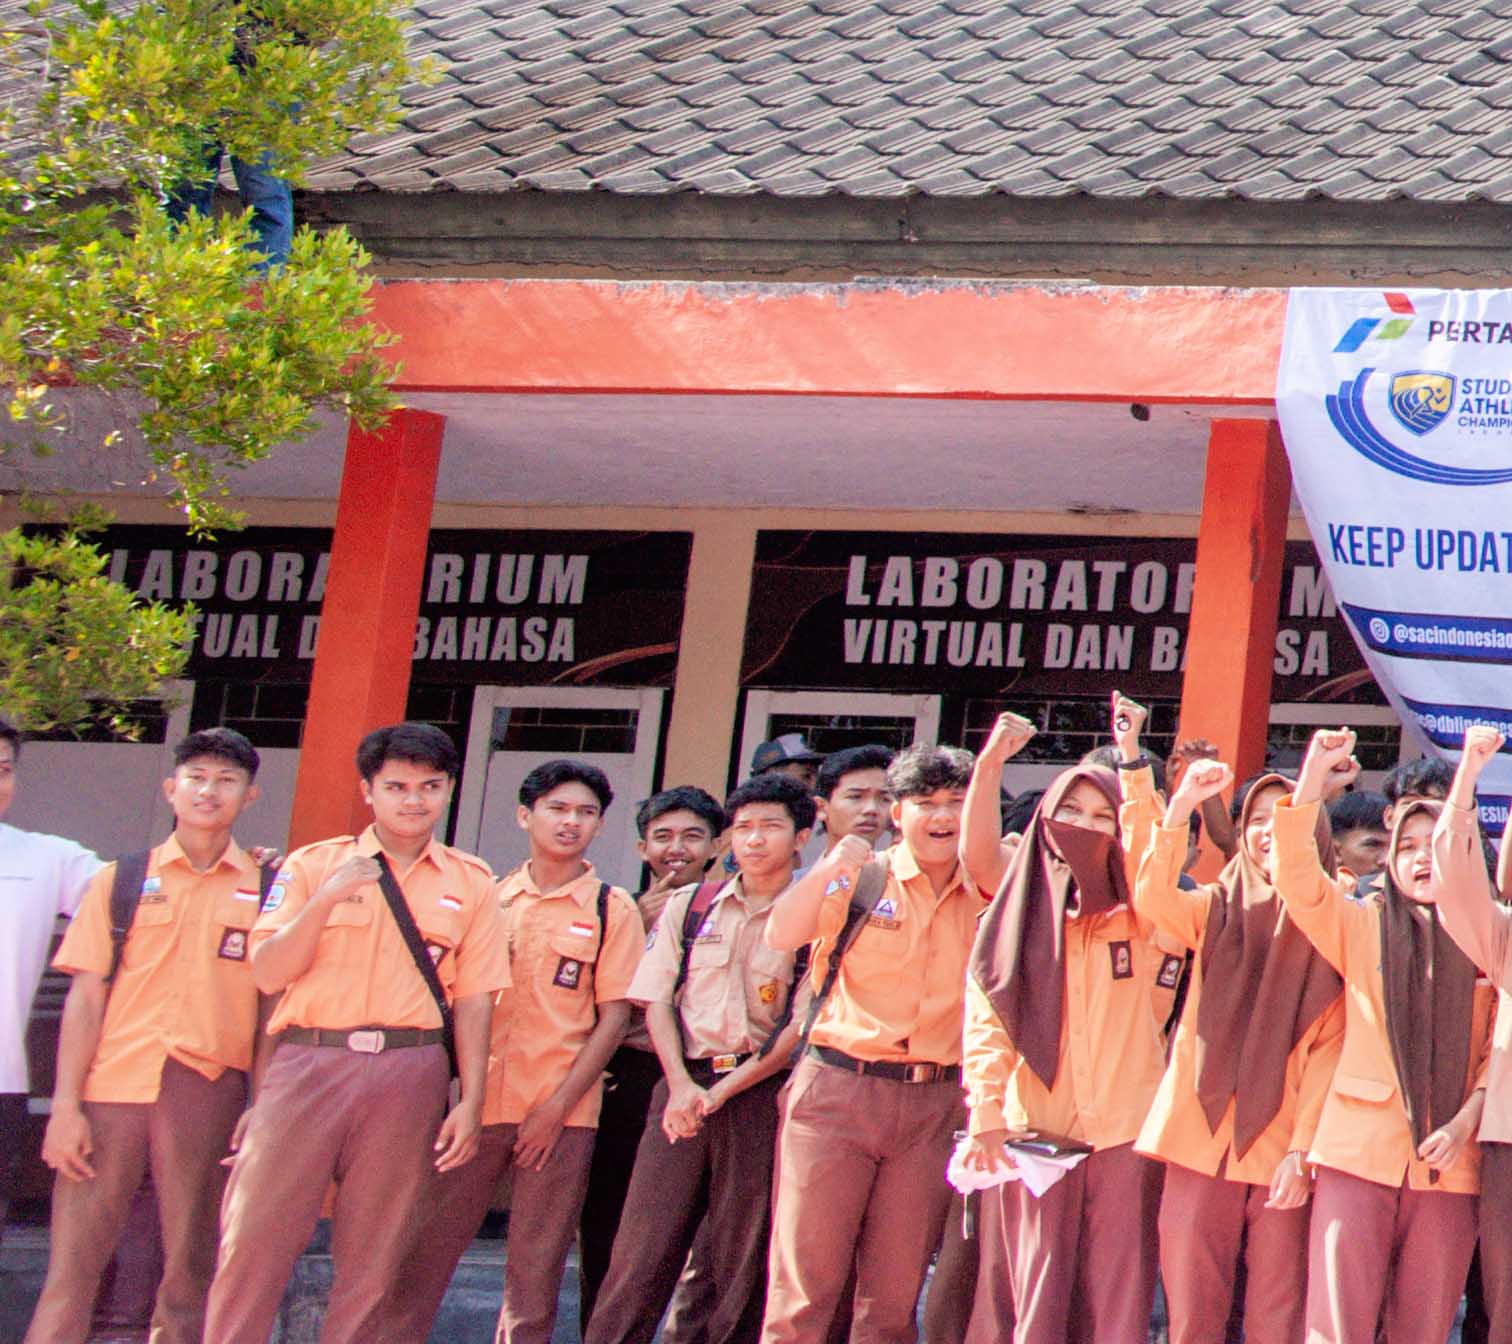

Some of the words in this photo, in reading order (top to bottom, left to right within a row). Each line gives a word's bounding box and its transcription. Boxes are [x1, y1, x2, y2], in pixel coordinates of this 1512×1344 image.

[1328, 522, 1406, 568] KEEP
[842, 618, 1026, 669] VIRTUAL
[1043, 624, 1136, 672] DAN
